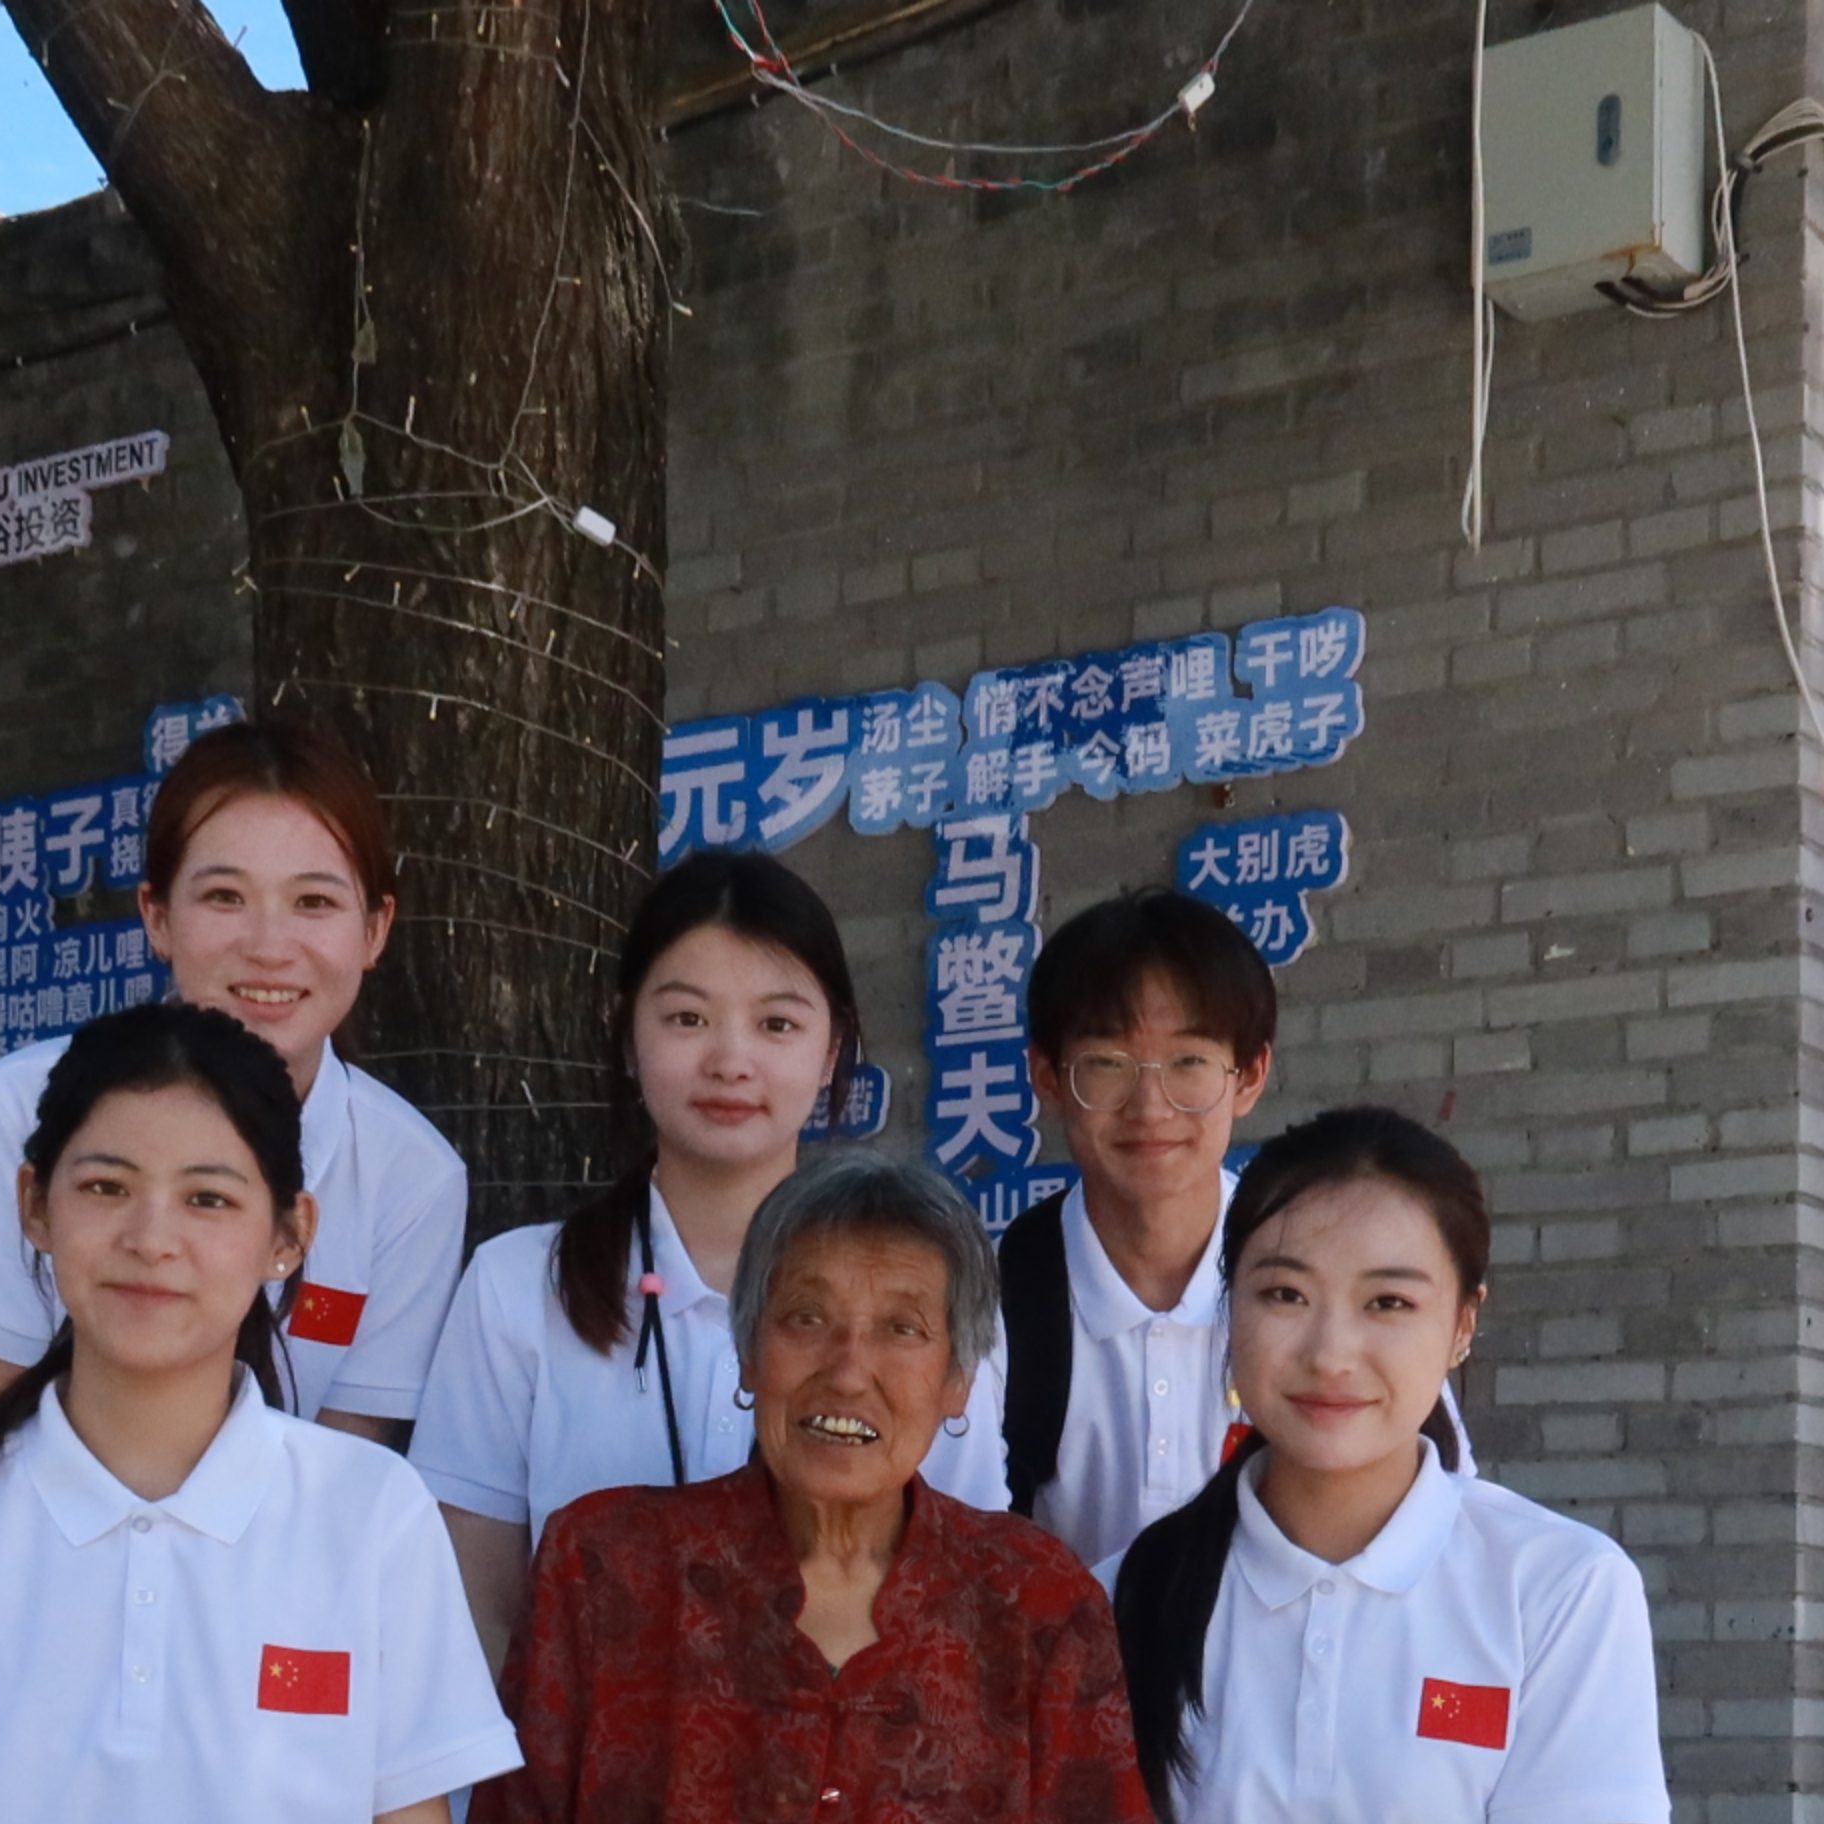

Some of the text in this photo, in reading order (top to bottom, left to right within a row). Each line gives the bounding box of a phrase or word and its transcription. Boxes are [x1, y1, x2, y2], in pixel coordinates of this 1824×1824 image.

[17, 437, 159, 496] INVESTMENT
[861, 619, 1348, 755] 汤尘 悄不念声哩 干哕
[658, 709, 849, 856] 元岁
[860, 693, 1346, 822] 茅子 解手 今码 菜虎子
[1188, 825, 1330, 891] 大别虎
[52, 928, 153, 979] 凉儿哩
